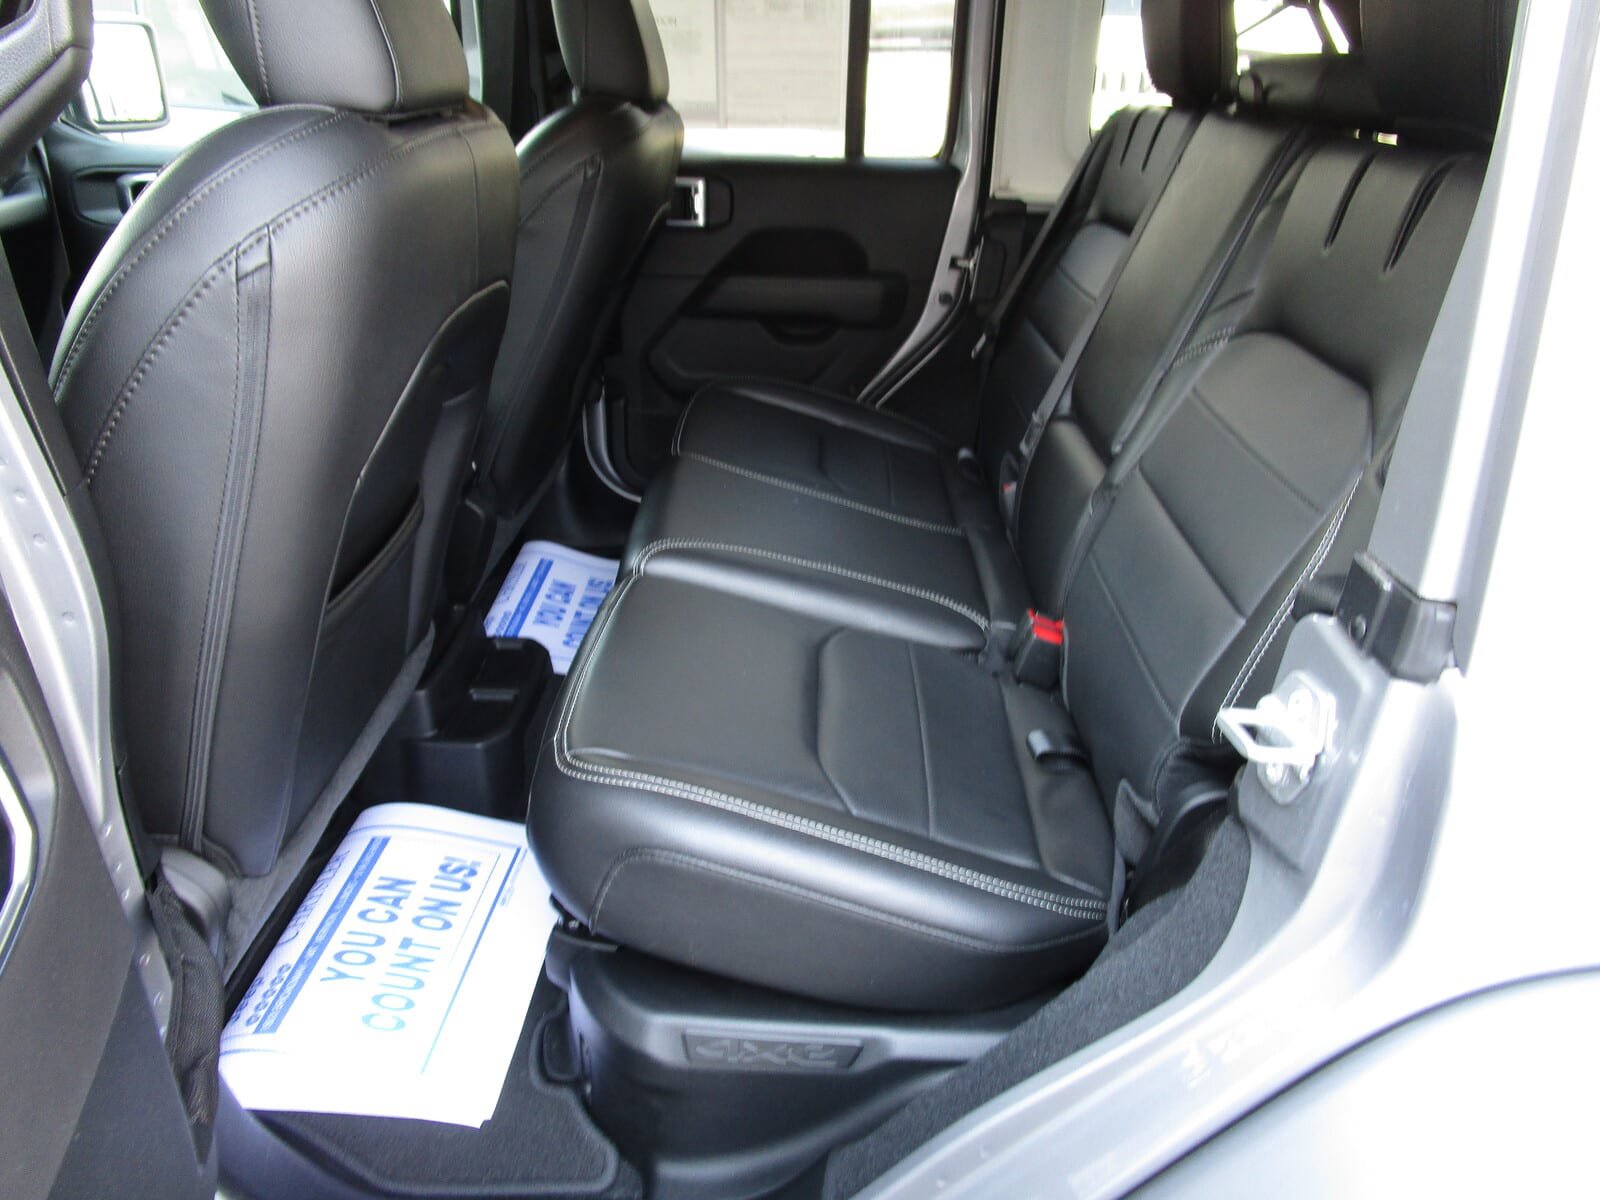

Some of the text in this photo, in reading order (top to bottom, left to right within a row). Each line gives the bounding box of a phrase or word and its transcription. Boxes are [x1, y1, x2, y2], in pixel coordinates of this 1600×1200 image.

[320, 931, 387, 983] YOU
[357, 875, 417, 925] CAN
[361, 856, 482, 1032] COUNT ON US!
